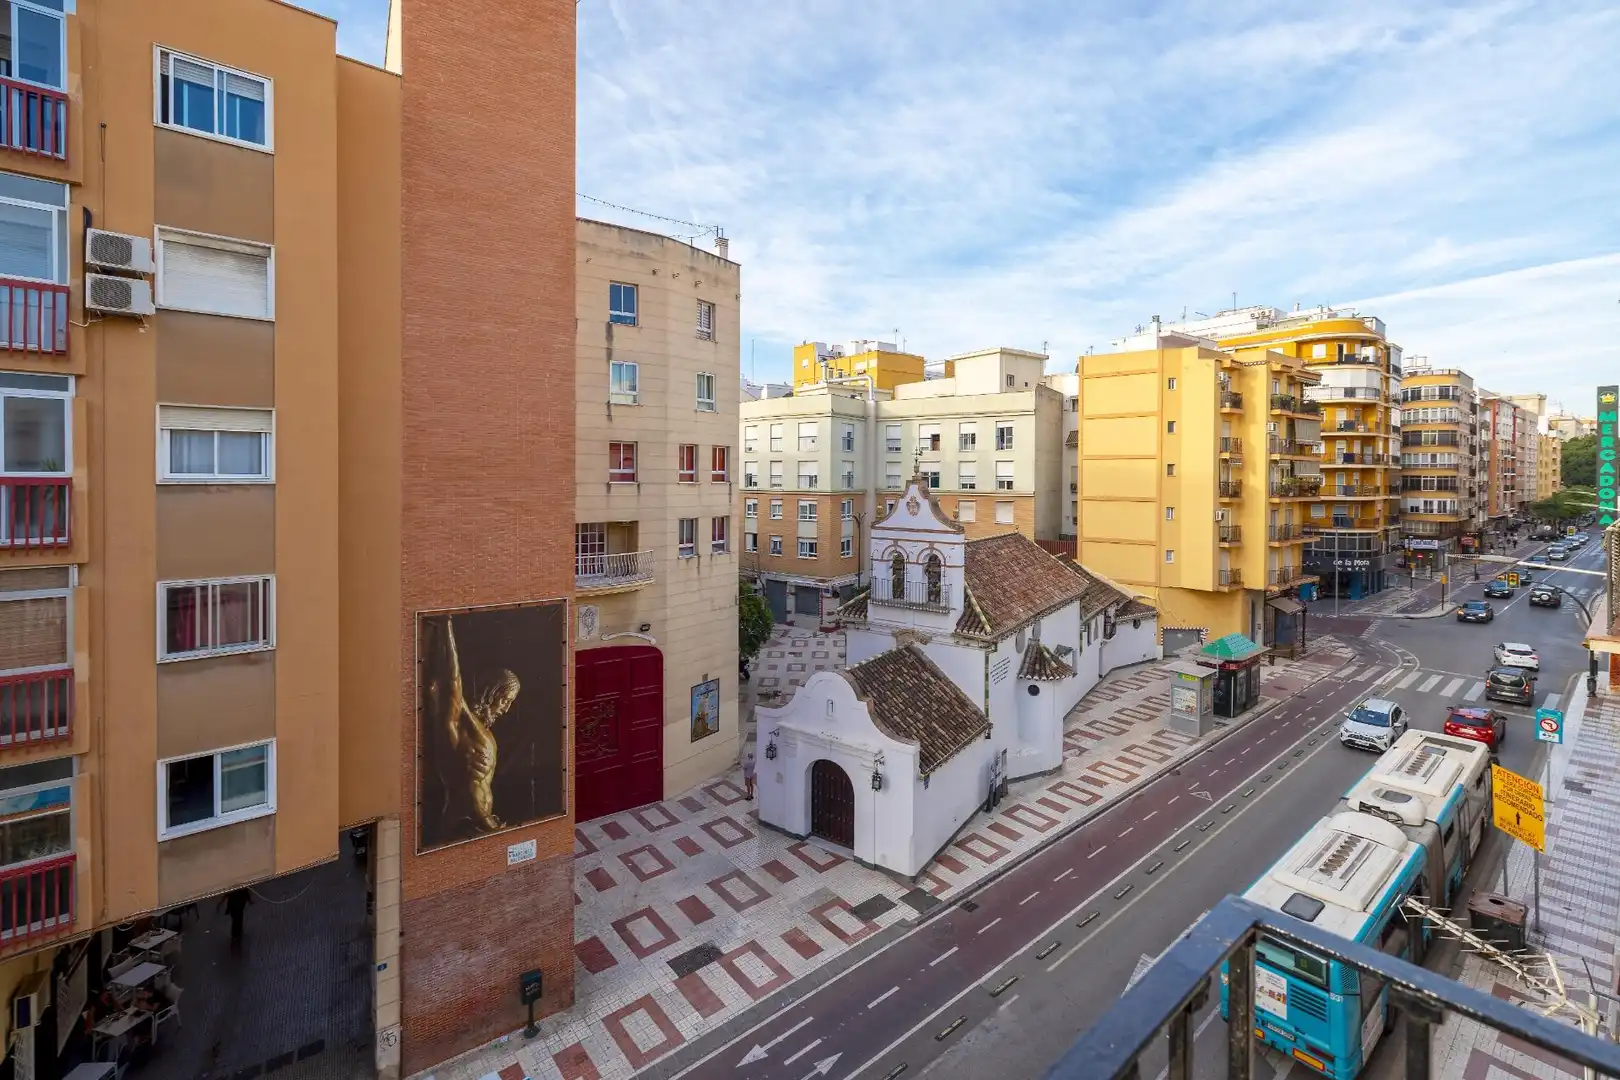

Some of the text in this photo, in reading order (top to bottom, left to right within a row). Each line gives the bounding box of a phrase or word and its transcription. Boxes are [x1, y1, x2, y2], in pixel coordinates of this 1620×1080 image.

[1598, 410, 1617, 525] MERCADONA
[1494, 792, 1543, 822] RECOMENDADO
[1500, 789, 1536, 811] ITINERARIO
